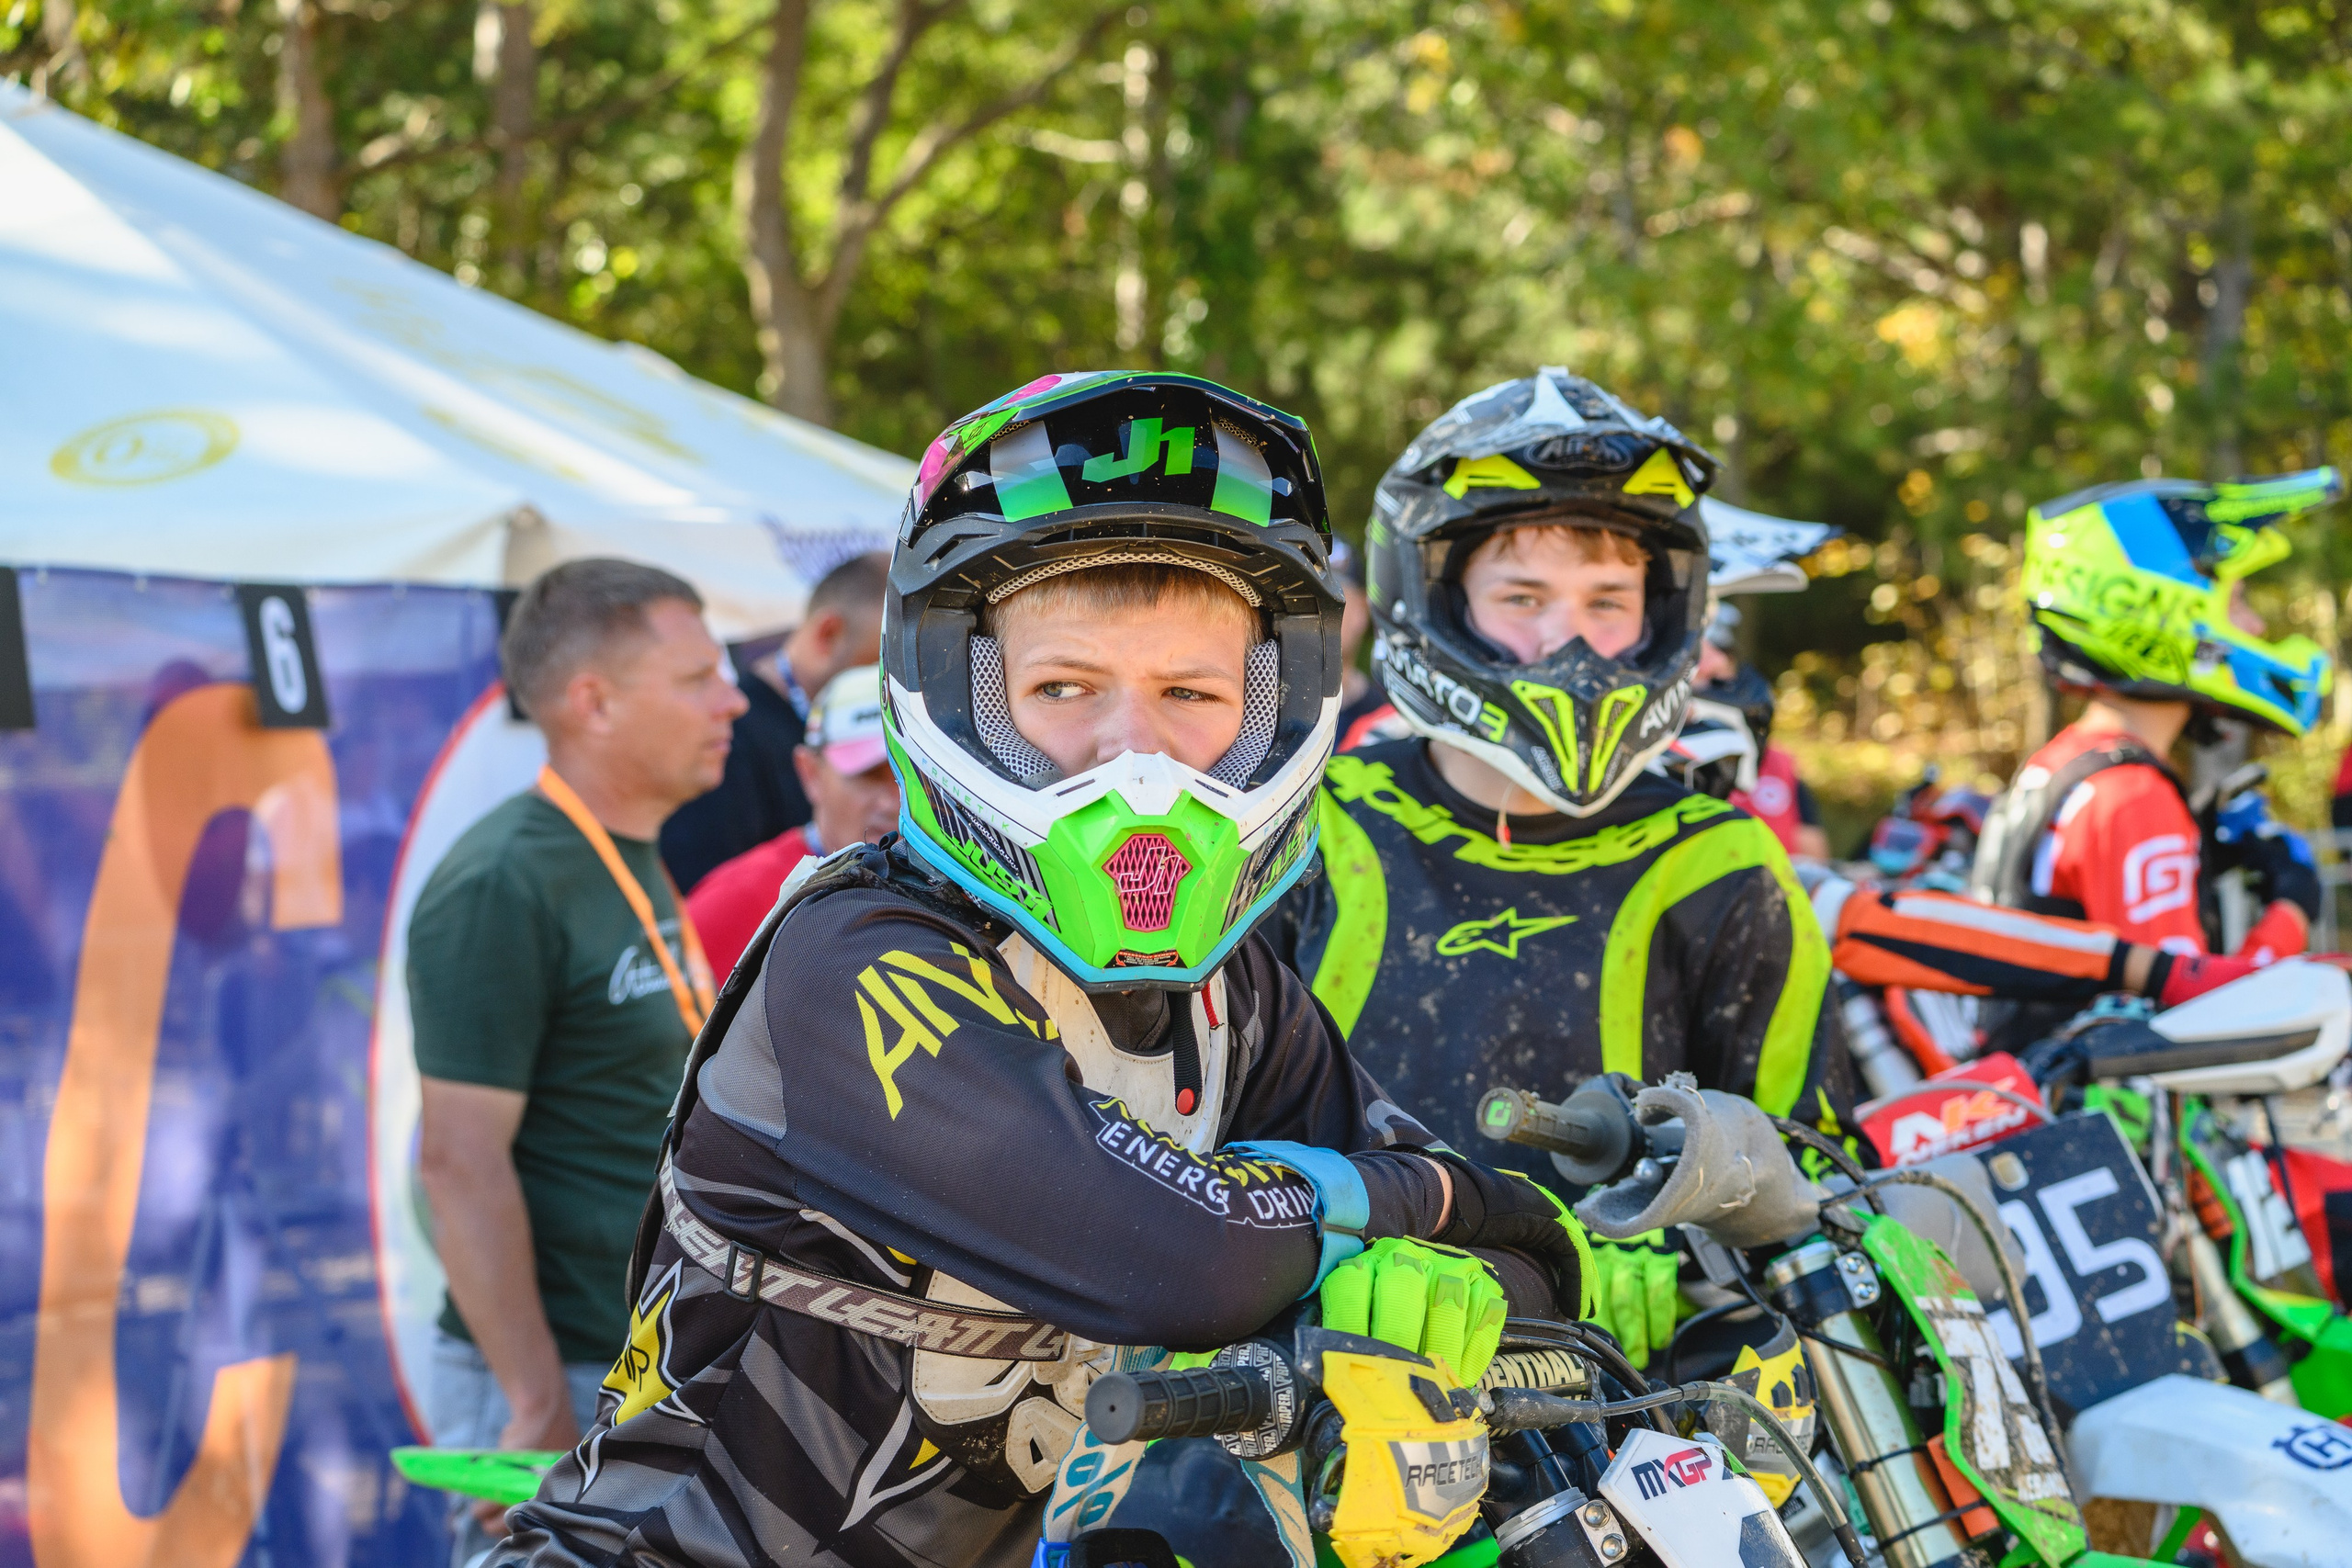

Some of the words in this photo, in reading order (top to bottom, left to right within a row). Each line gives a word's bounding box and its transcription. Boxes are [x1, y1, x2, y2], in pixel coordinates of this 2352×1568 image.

[258, 596, 308, 714] 6
[922, 757, 1010, 832] FRENETIK
[1247, 1183, 1316, 1220] DRIN
[1631, 1447, 1713, 1501] MXGP
